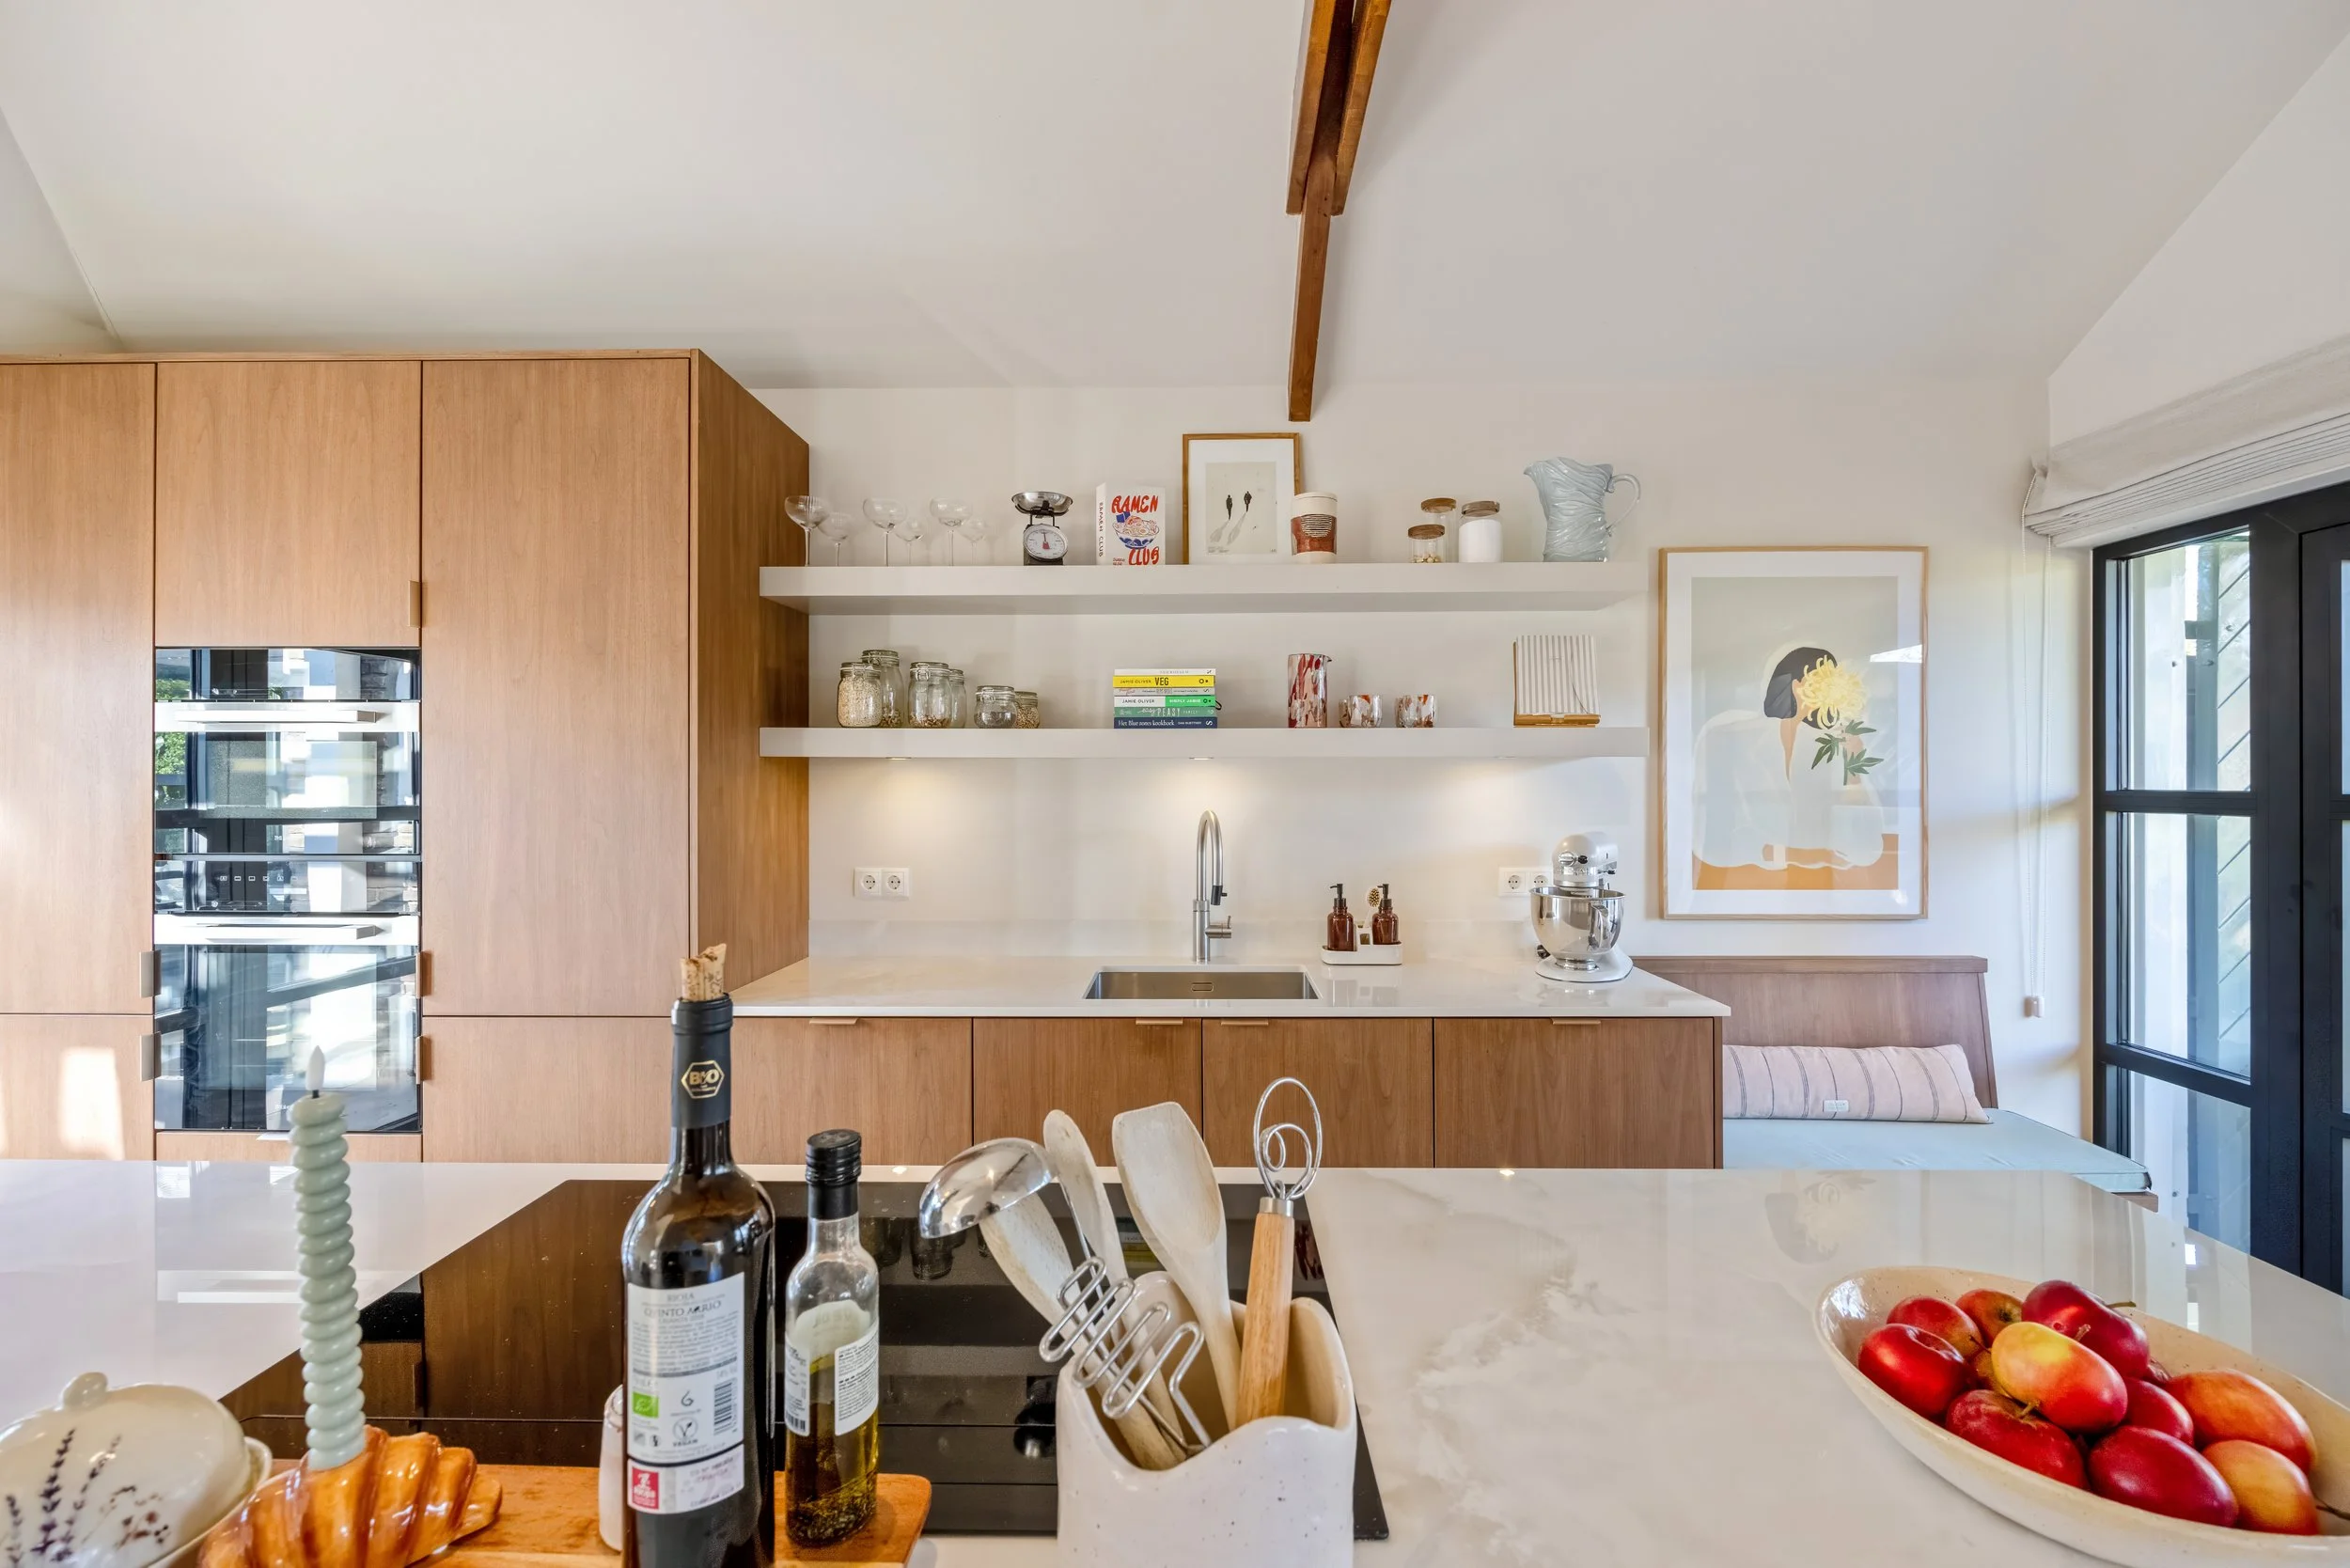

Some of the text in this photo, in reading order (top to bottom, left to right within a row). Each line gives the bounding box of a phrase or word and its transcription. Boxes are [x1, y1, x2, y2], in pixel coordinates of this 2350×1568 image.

[1111, 494, 1159, 514] RAMEN
[1128, 545, 1160, 566] CLUB
[1154, 677, 1169, 686] VEG
